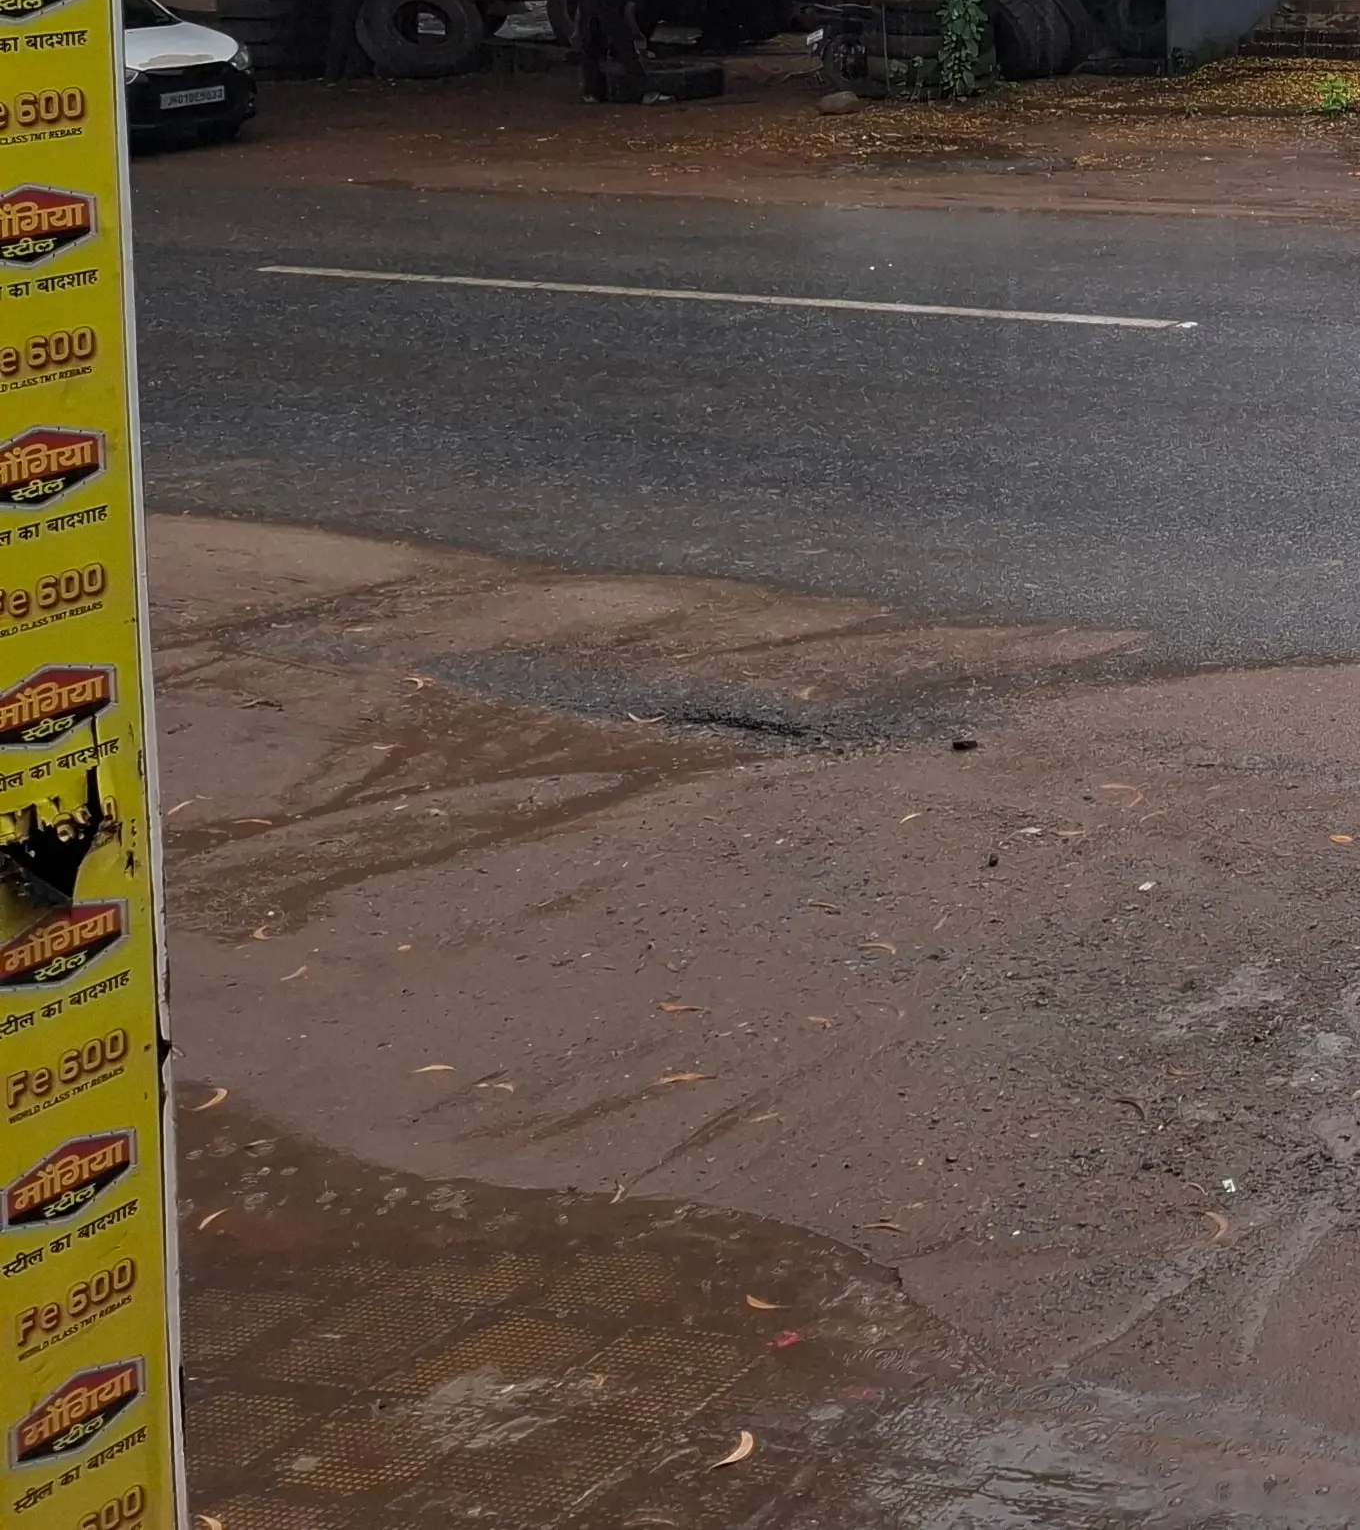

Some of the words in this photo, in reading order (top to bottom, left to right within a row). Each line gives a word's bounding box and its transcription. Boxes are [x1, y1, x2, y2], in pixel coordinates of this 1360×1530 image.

[15, 86, 86, 126] 600
[26, 326, 97, 370] 600
[36, 562, 107, 610] 600
[6, 1067, 50, 1108] Fe
[58, 1028, 128, 1084] 600
[16, 1301, 61, 1346] Fe
[67, 1257, 135, 1317] 600
